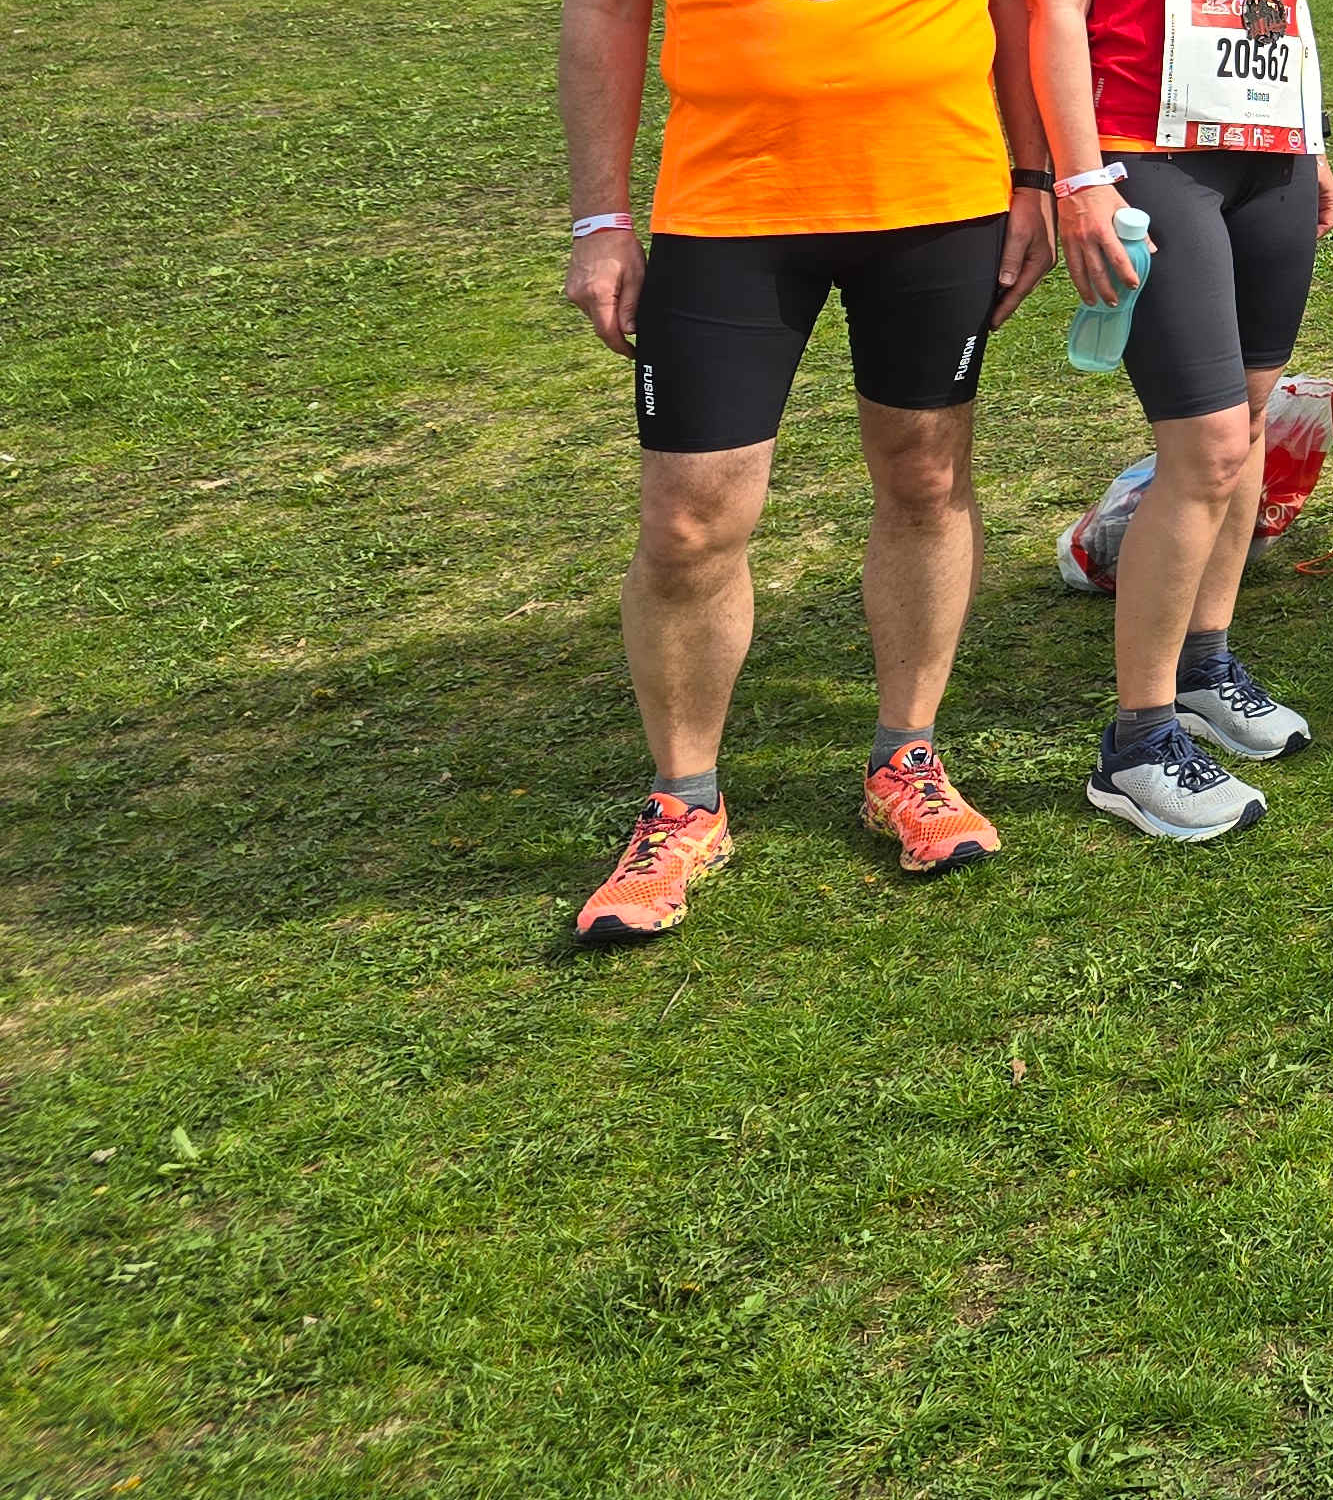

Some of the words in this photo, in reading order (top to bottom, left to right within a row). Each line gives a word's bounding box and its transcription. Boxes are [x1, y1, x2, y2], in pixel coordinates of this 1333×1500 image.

[1217, 37, 1289, 83] 20562
[954, 336, 977, 382] FUSION
[643, 364, 656, 416] FUSION
